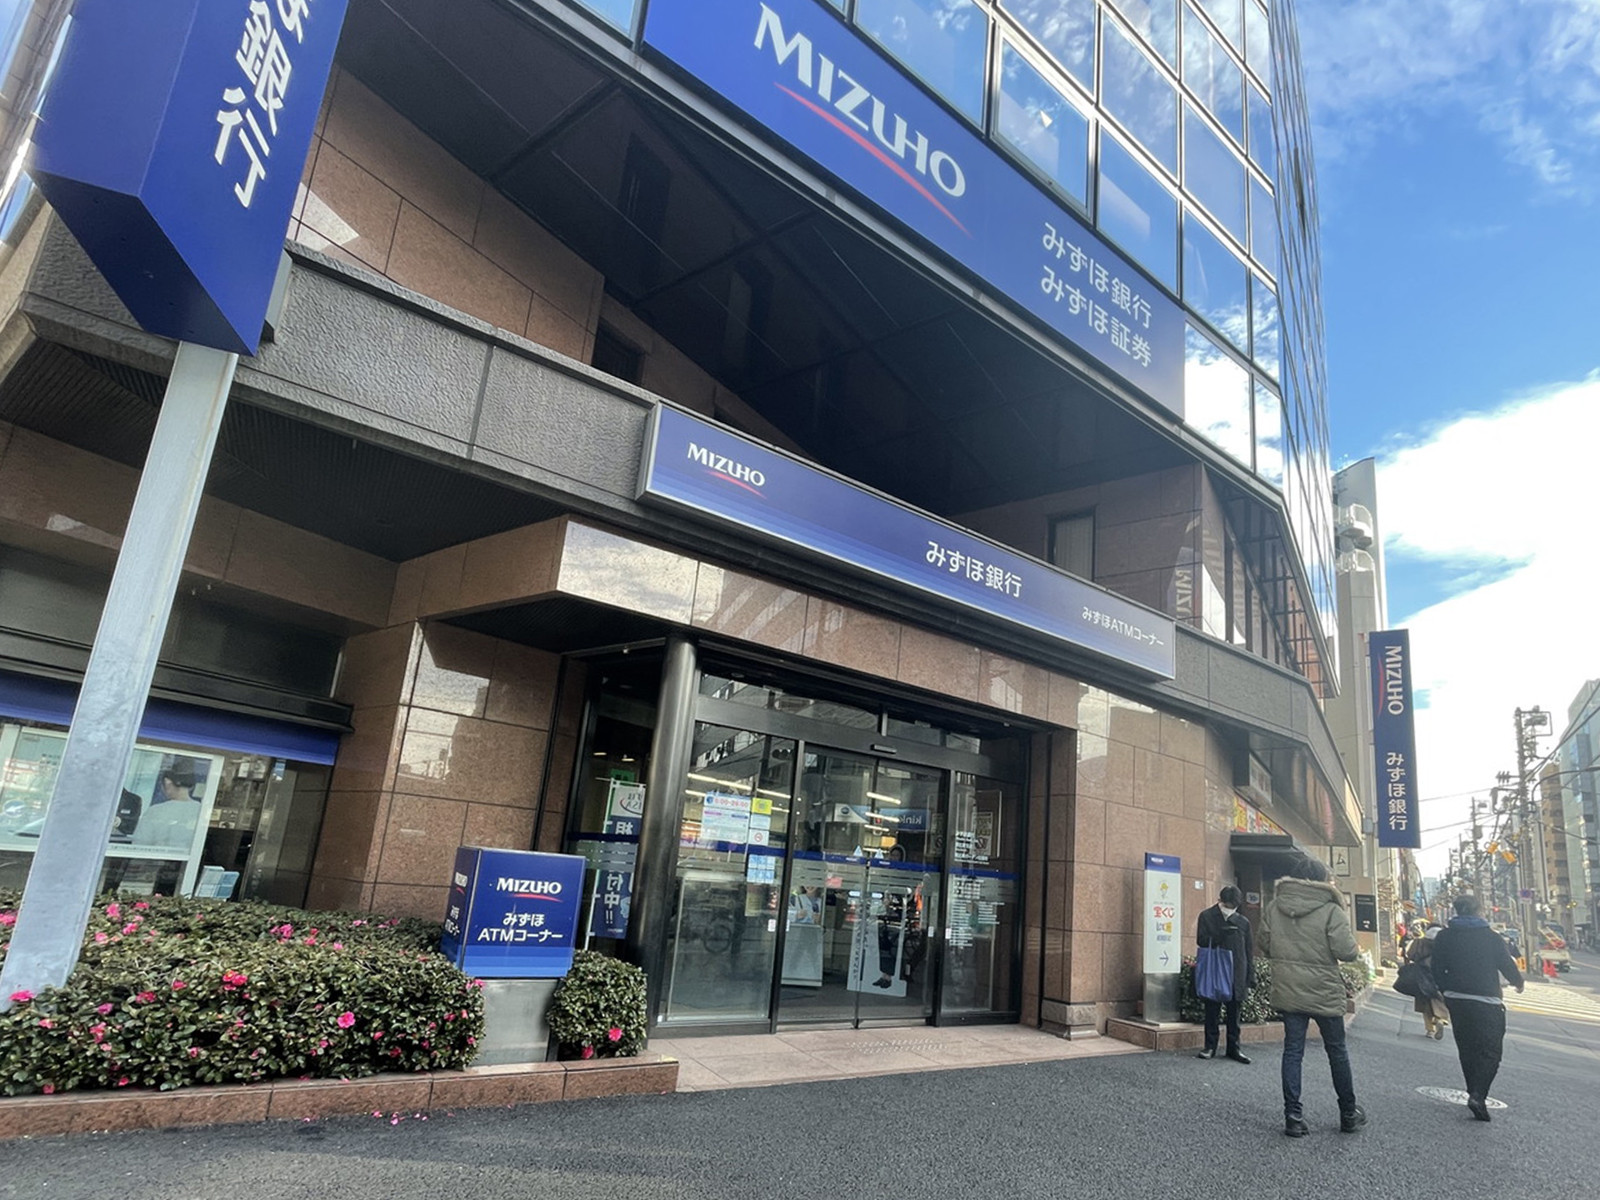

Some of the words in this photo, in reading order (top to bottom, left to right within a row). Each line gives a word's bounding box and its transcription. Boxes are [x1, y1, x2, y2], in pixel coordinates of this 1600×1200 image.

[753, 2, 966, 197] MIZUHO
[1042, 222, 1152, 327] みずほ銀行
[1041, 266, 1152, 368] みずほ証券
[687, 442, 766, 487] MIZUHO
[926, 541, 1022, 598] みずほ銀行
[1082, 606, 1164, 647] みずほATMコーナー
[1385, 645, 1404, 716] MIZUHO
[1386, 752, 1408, 831] みずほ銀行
[496, 877, 562, 895] MIZUHO
[477, 927, 563, 943] ATMコーナー
[503, 912, 545, 927] みずほ
[1153, 906, 1175, 918] 宝くじ
